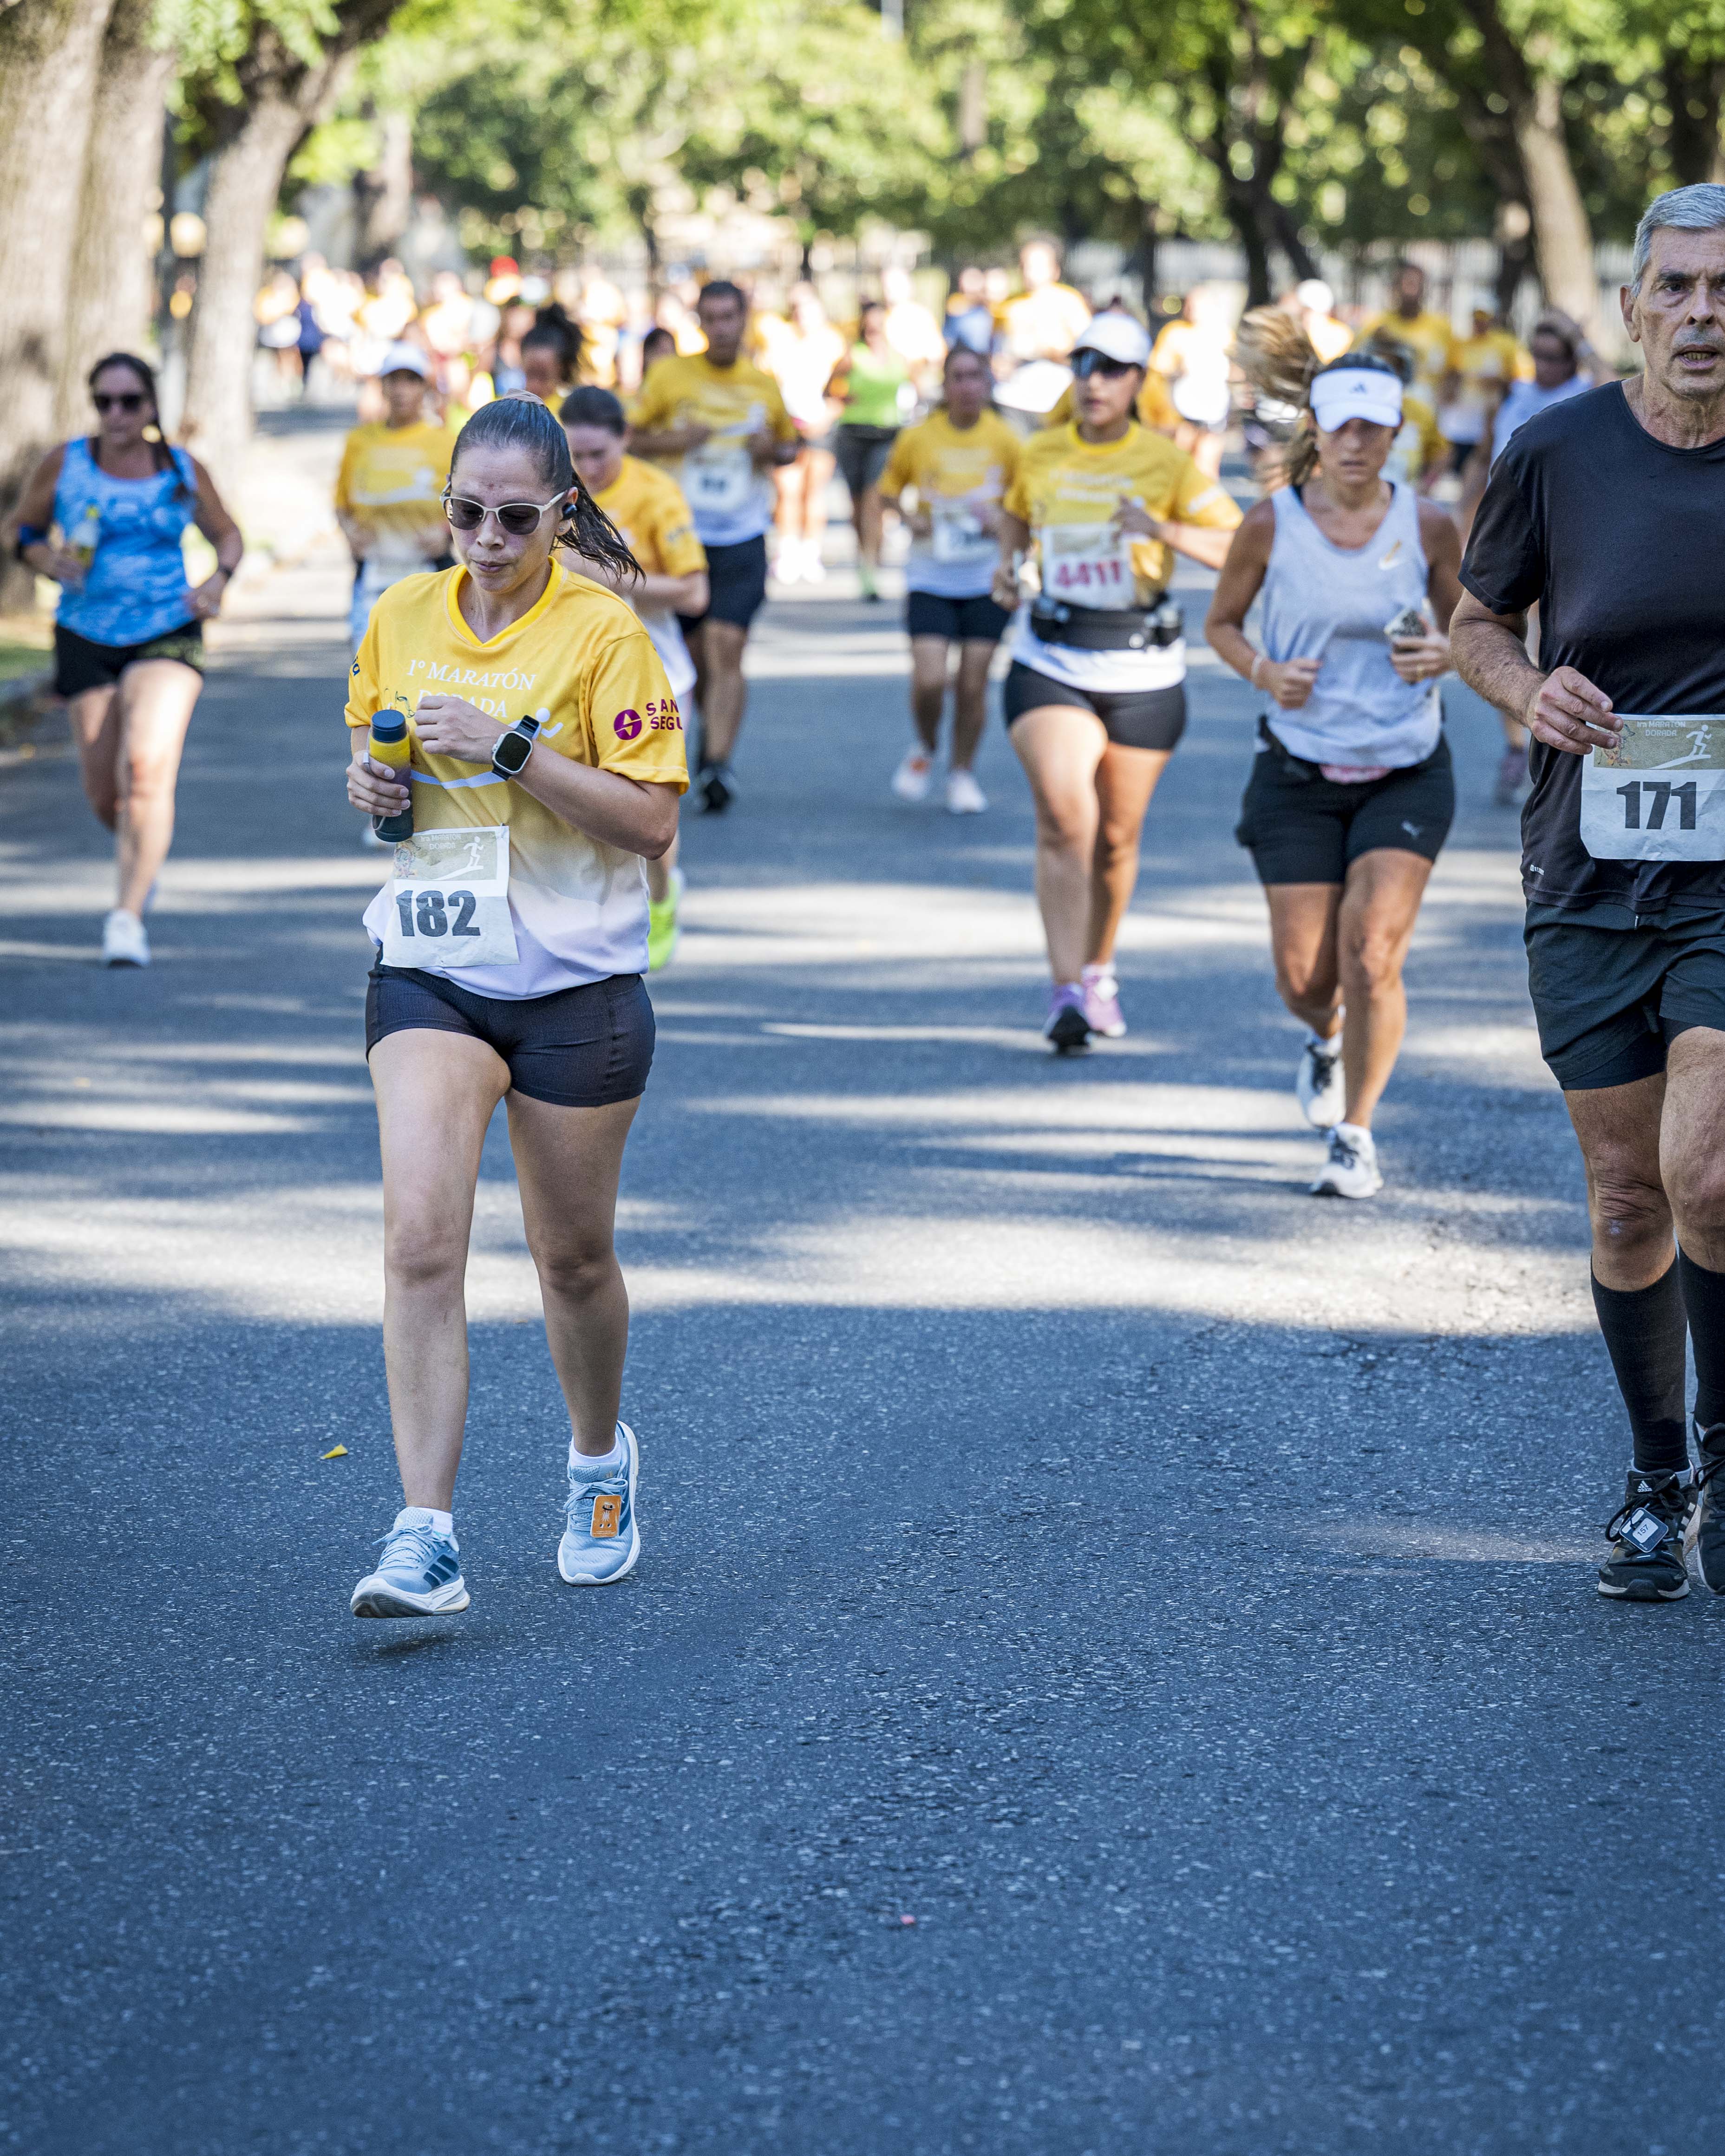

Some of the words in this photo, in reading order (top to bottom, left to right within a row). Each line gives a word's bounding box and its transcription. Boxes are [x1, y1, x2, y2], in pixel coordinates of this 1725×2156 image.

[426, 661, 537, 690] MARATÓN
[1616, 781, 1697, 830] 171
[396, 890, 481, 937] 182
[1637, 1524, 1648, 1536] 157
